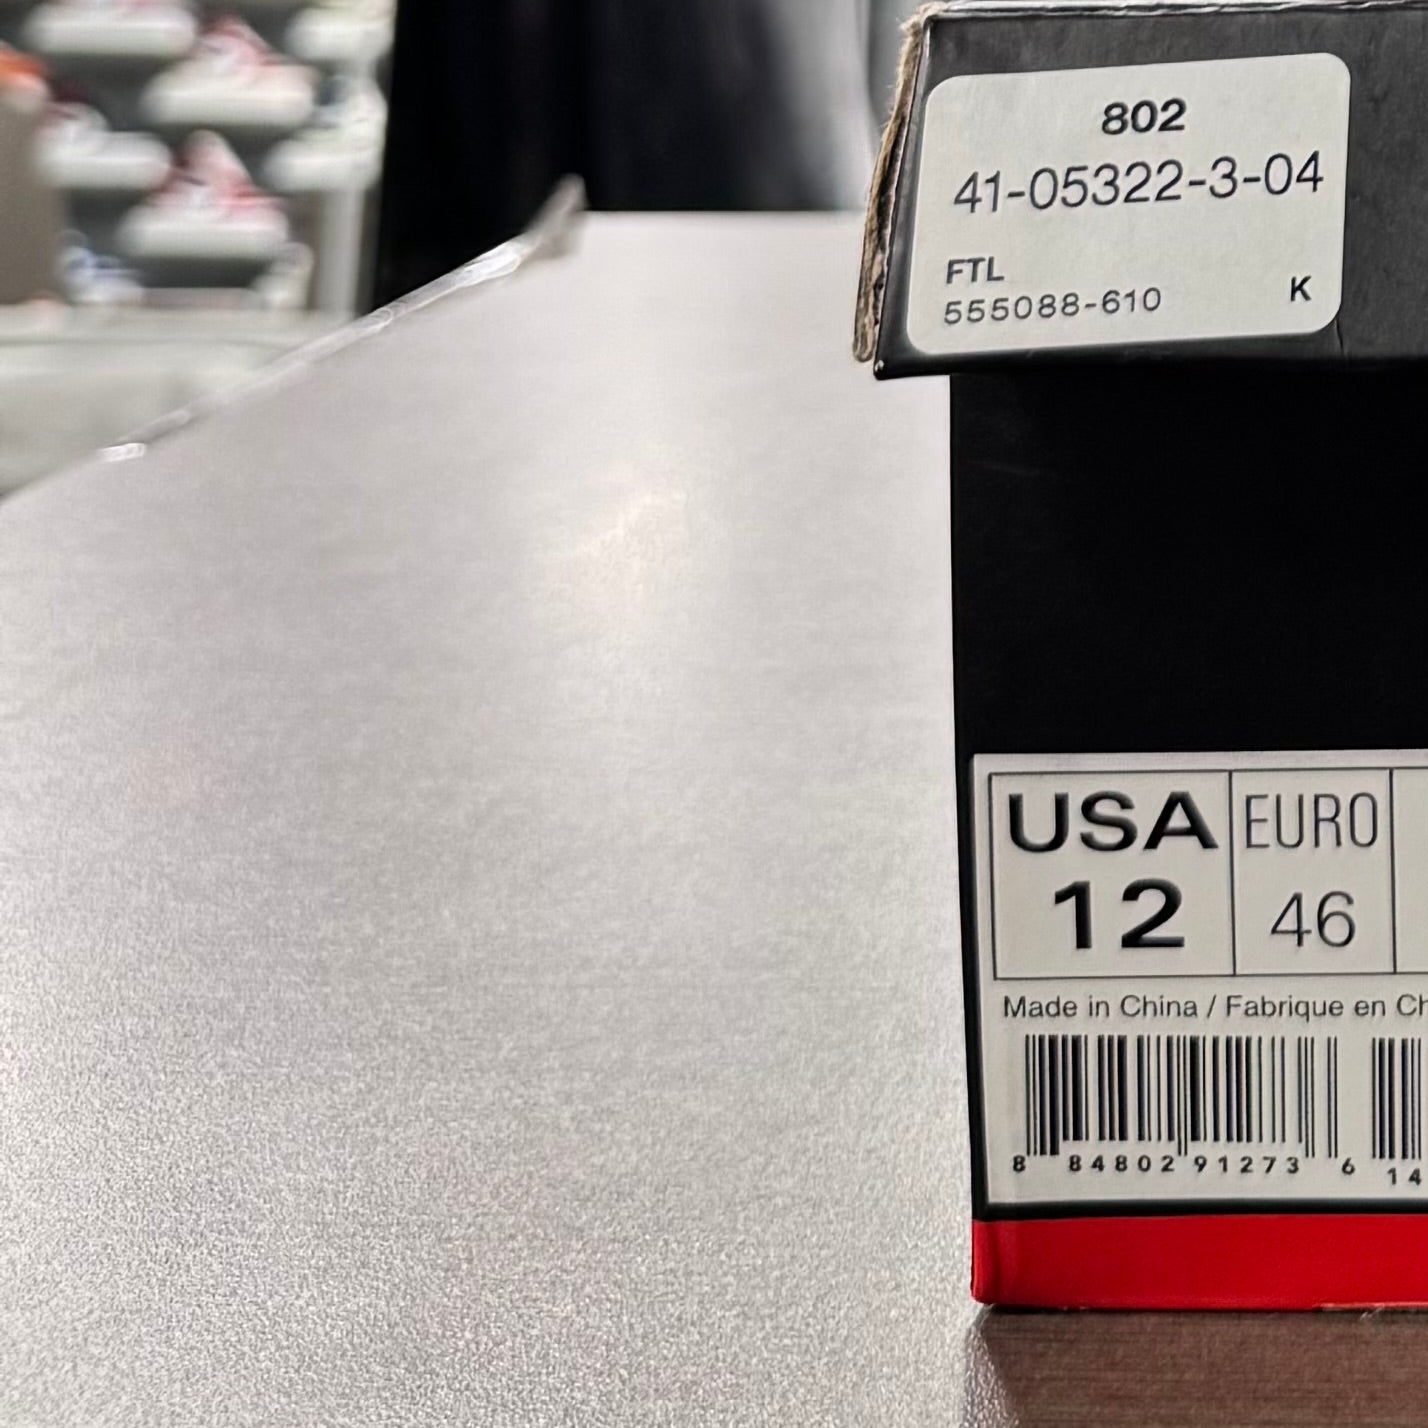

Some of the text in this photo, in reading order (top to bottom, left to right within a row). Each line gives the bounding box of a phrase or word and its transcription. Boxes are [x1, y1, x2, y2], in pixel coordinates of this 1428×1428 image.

[1101, 97, 1187, 136] 802
[953, 150, 1324, 214] 41-05322-3-04
[945, 256, 1005, 285] FTL
[1290, 275, 1312, 302] K
[943, 287, 1162, 326] 555088-610
[1008, 791, 1219, 854] USA
[1245, 792, 1378, 849] EURO
[1054, 879, 1185, 950] 12
[1270, 891, 1356, 948] 46
[1003, 995, 1078, 1018] Made
[1088, 995, 1110, 1018] in
[1119, 994, 1198, 1018] China
[1205, 994, 1218, 1019] /
[1226, 994, 1344, 1023] Fabrique
[1353, 1000, 1386, 1017] en
